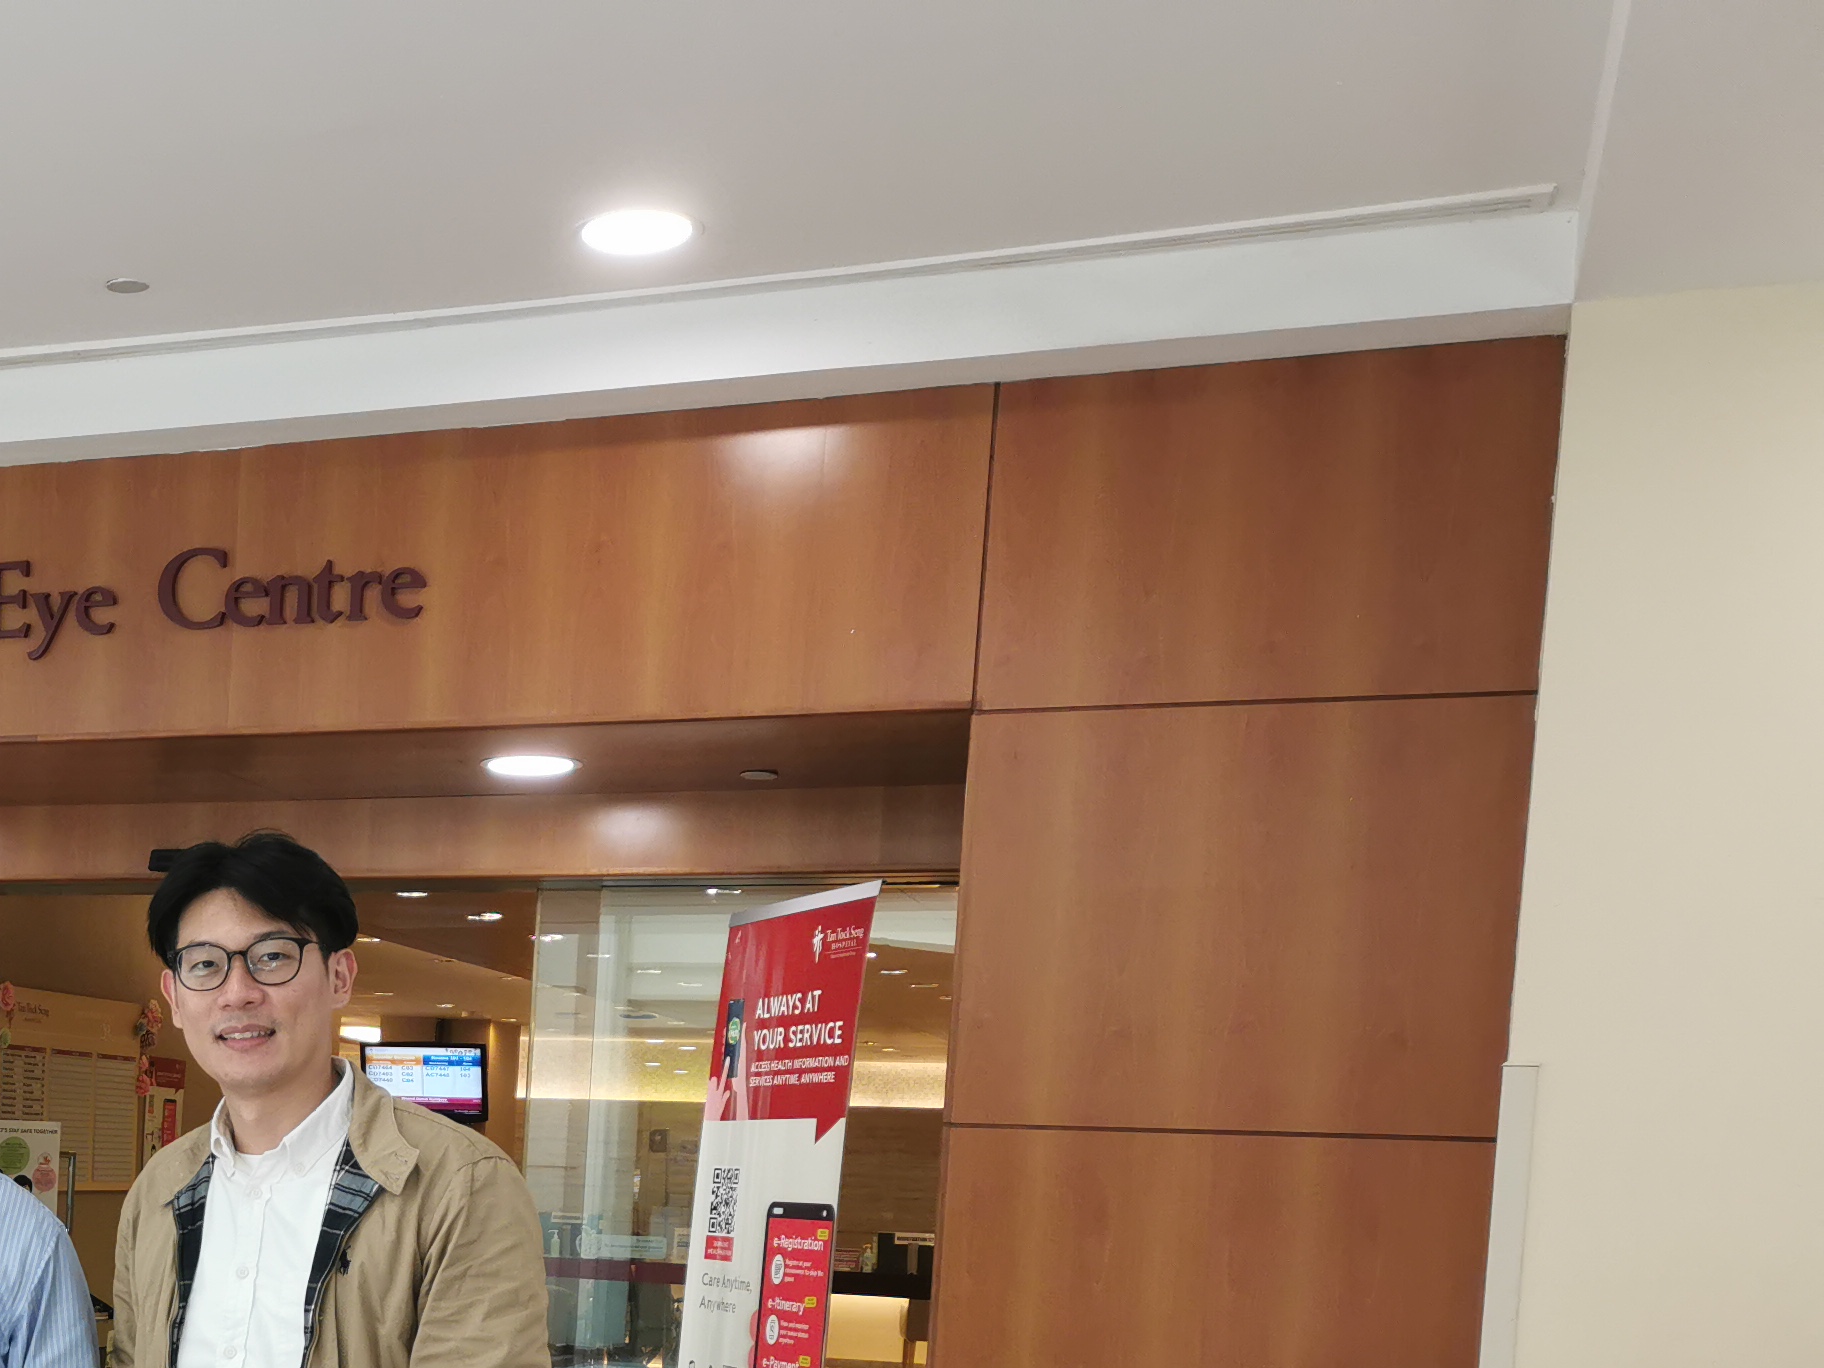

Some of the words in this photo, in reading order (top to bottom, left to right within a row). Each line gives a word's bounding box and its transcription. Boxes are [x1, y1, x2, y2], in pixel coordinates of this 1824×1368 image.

[157, 546, 428, 632] Centre
[756, 993, 802, 1019] ALWAYS
[804, 989, 822, 1013] AT
[753, 1027, 785, 1051] YOUR
[788, 1021, 844, 1048] SERVICE
[750, 1061, 770, 1073] ACCESS
[771, 1059, 792, 1071] HEALTH
[794, 1056, 834, 1069] INFORMATION
[835, 1055, 849, 1066] AND
[749, 1076, 772, 1087] SERVICES
[801, 1072, 835, 1083] ANYWHERE
[773, 1234, 824, 1251] e-Registration
[701, 1272, 720, 1288] Care
[721, 1274, 752, 1294] Anytime,
[699, 1295, 736, 1313] Anywhere
